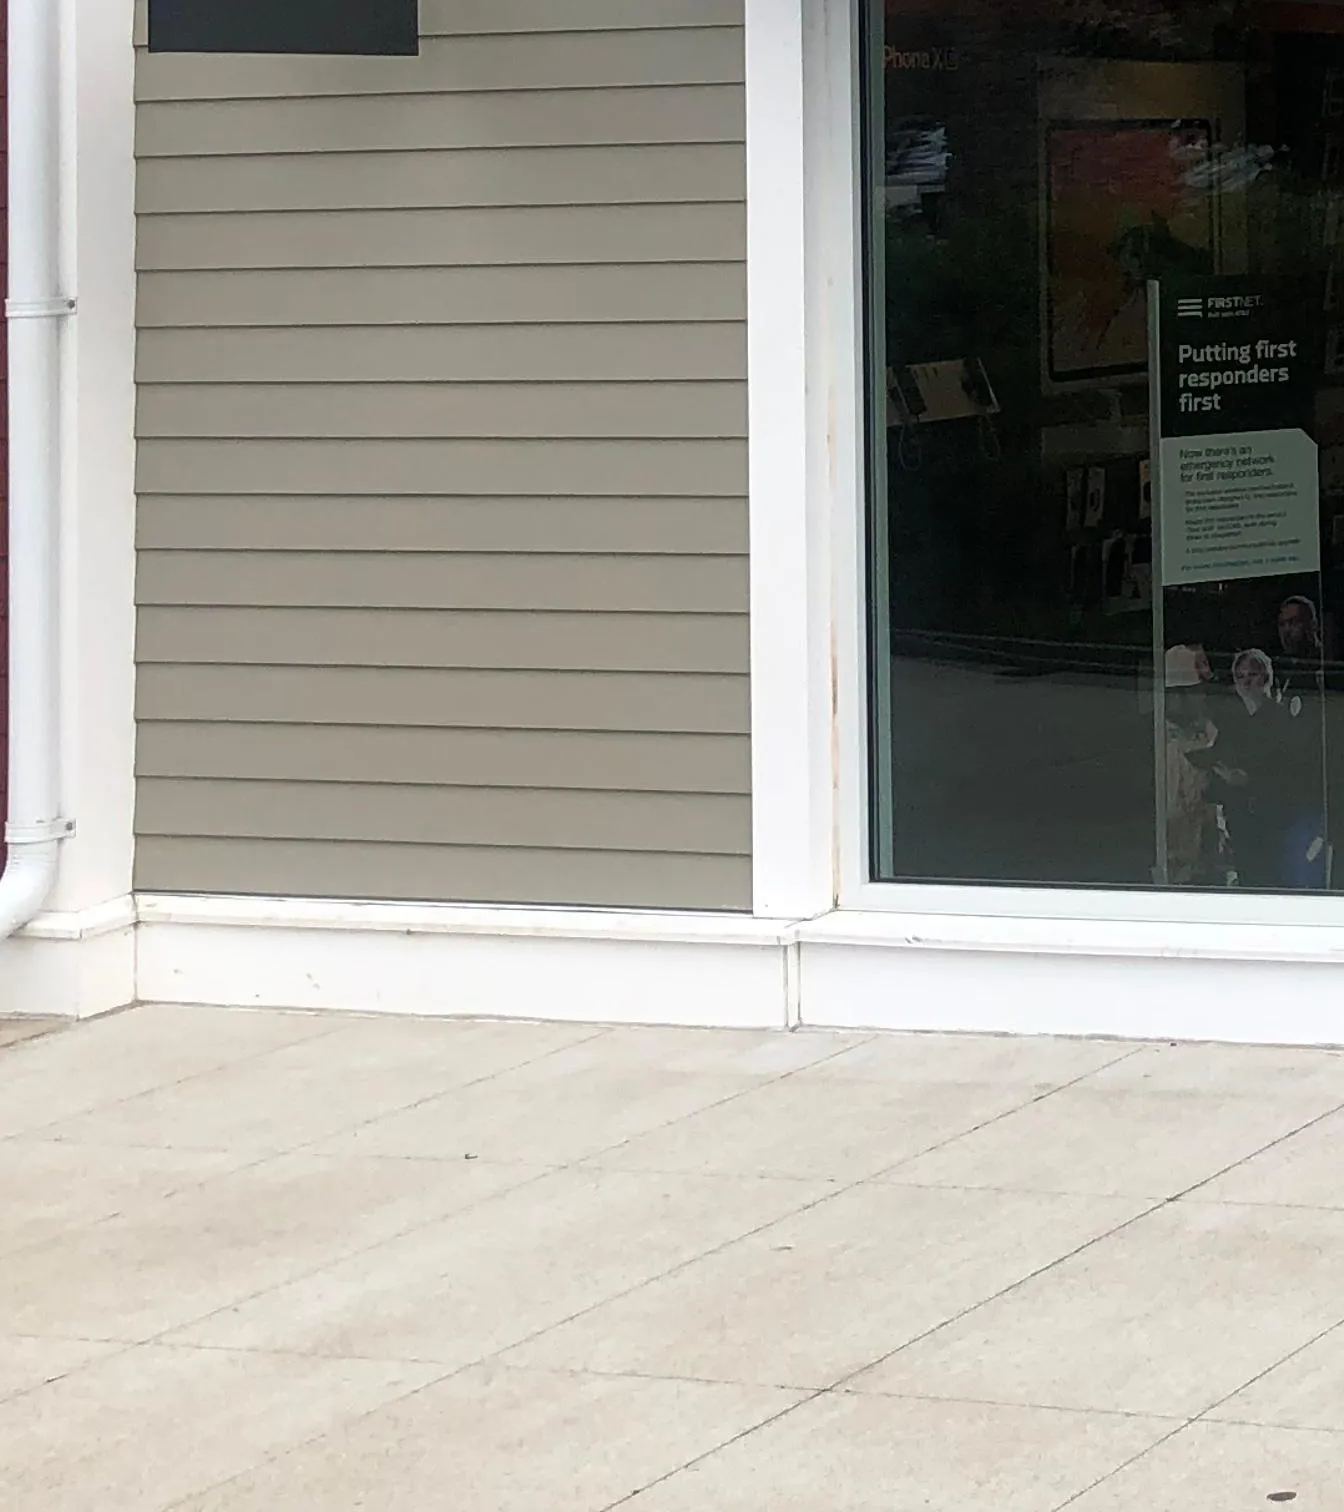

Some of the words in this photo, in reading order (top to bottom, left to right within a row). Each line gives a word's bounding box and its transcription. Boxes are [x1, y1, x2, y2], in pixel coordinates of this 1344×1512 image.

[1179, 342, 1251, 364] Putting
[1255, 340, 1297, 359] first
[1179, 364, 1289, 389] responders
[1179, 393, 1221, 412] first
